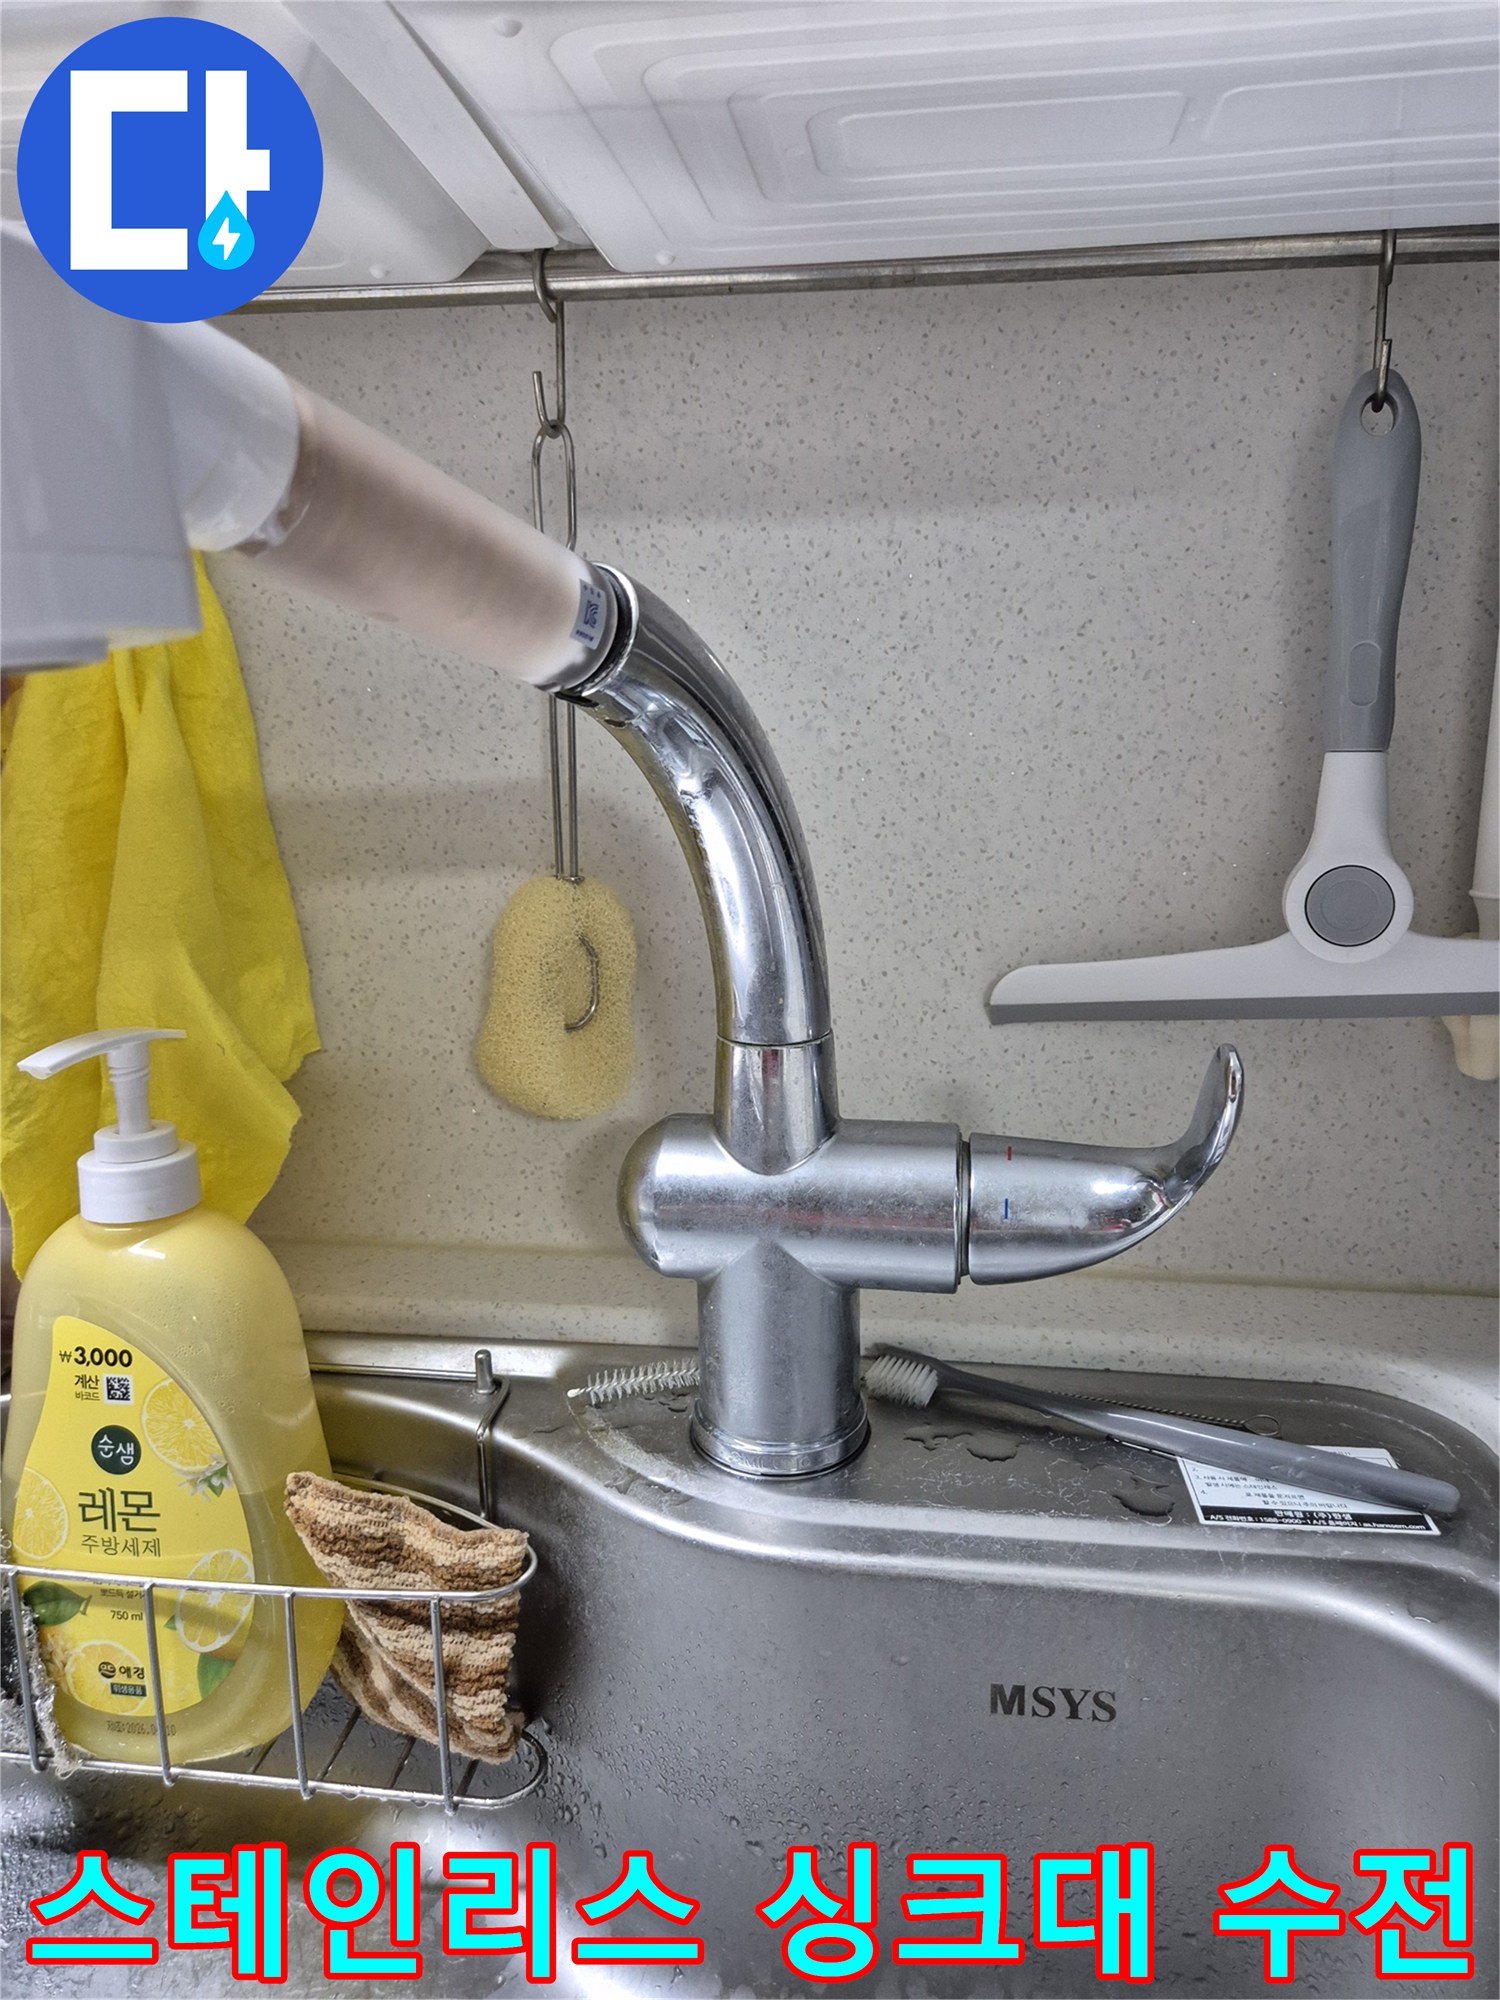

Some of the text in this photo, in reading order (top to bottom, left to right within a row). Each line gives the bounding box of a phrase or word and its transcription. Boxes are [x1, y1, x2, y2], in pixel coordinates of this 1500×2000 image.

[75, 1374, 99, 1390] 계산
[75, 1391, 101, 1401] 바코드
[98, 1434, 135, 1465] 순샘
[78, 1487, 161, 1533] 레몬
[81, 1535, 161, 1558] 주방세제
[110, 1610, 143, 1621] 750 ml
[118, 1663, 146, 1679] 애경
[990, 1683, 1117, 1722] MSYS
